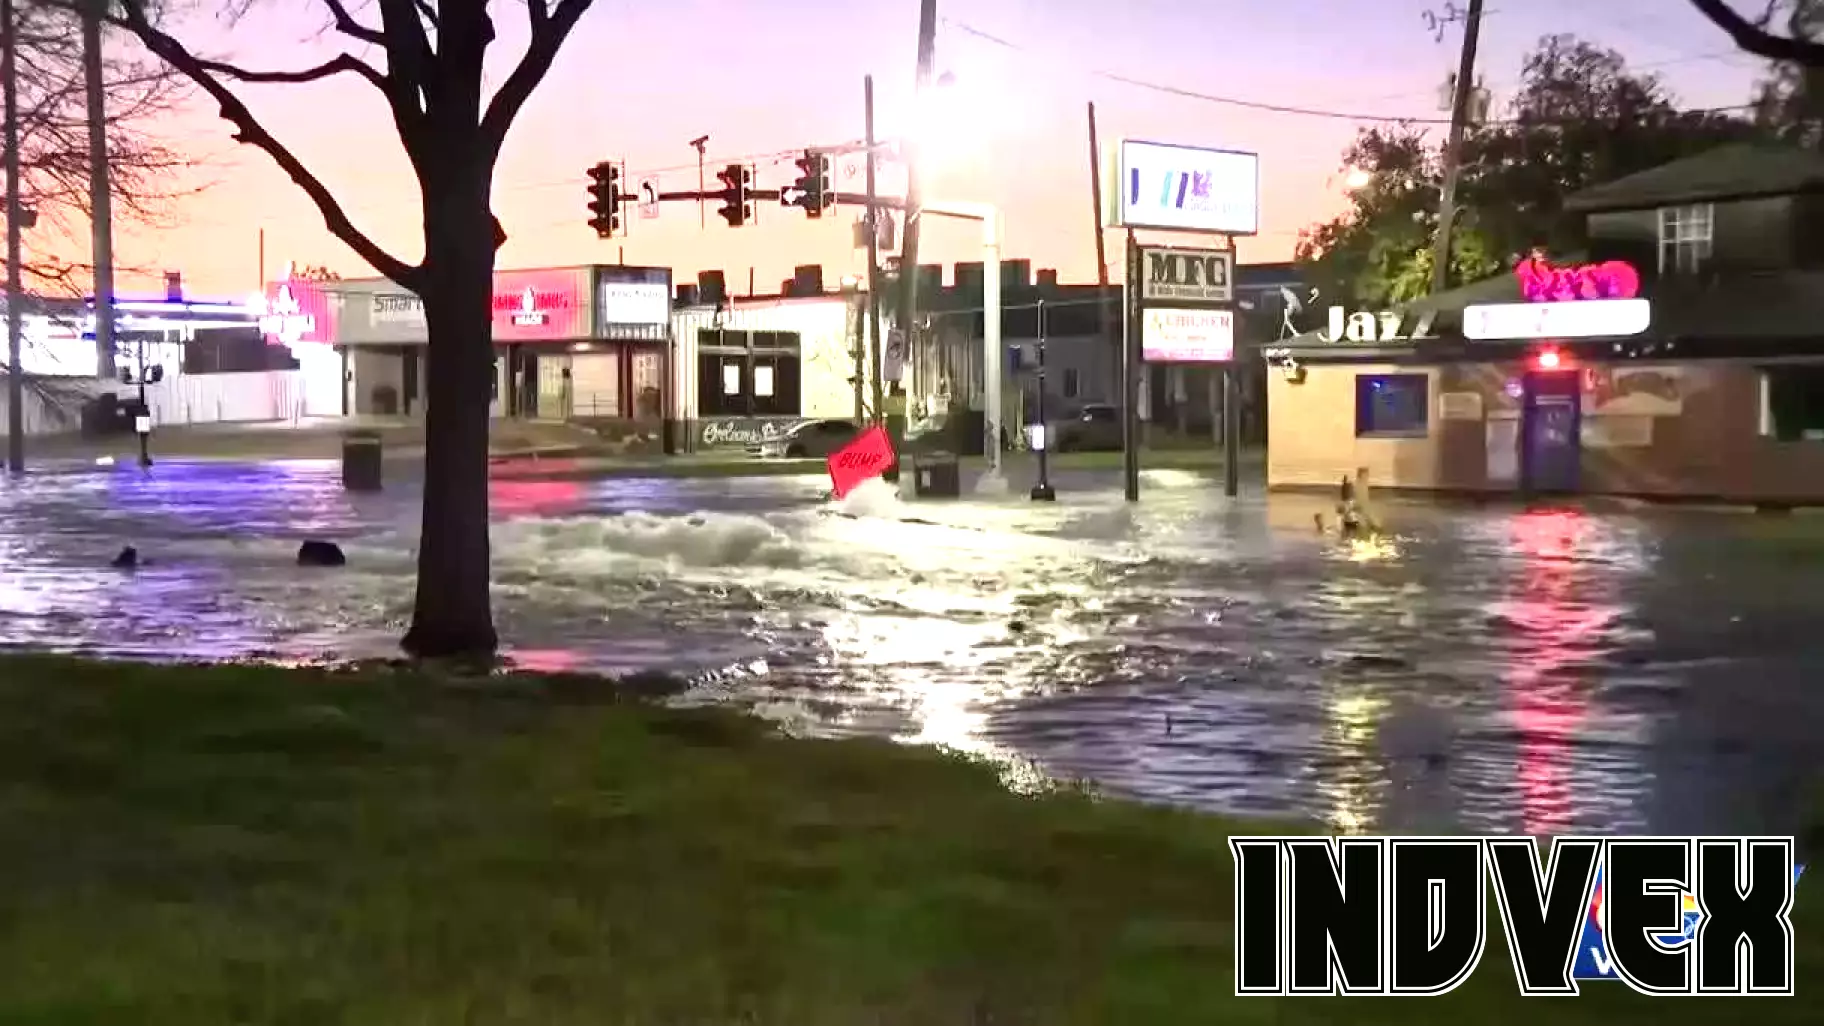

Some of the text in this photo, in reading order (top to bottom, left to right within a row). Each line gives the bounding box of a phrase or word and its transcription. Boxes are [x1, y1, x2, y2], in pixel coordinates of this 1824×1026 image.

[1150, 252, 1226, 286] MFG
[1317, 305, 1441, 343] Jazz
[839, 452, 882, 469] BUMP
